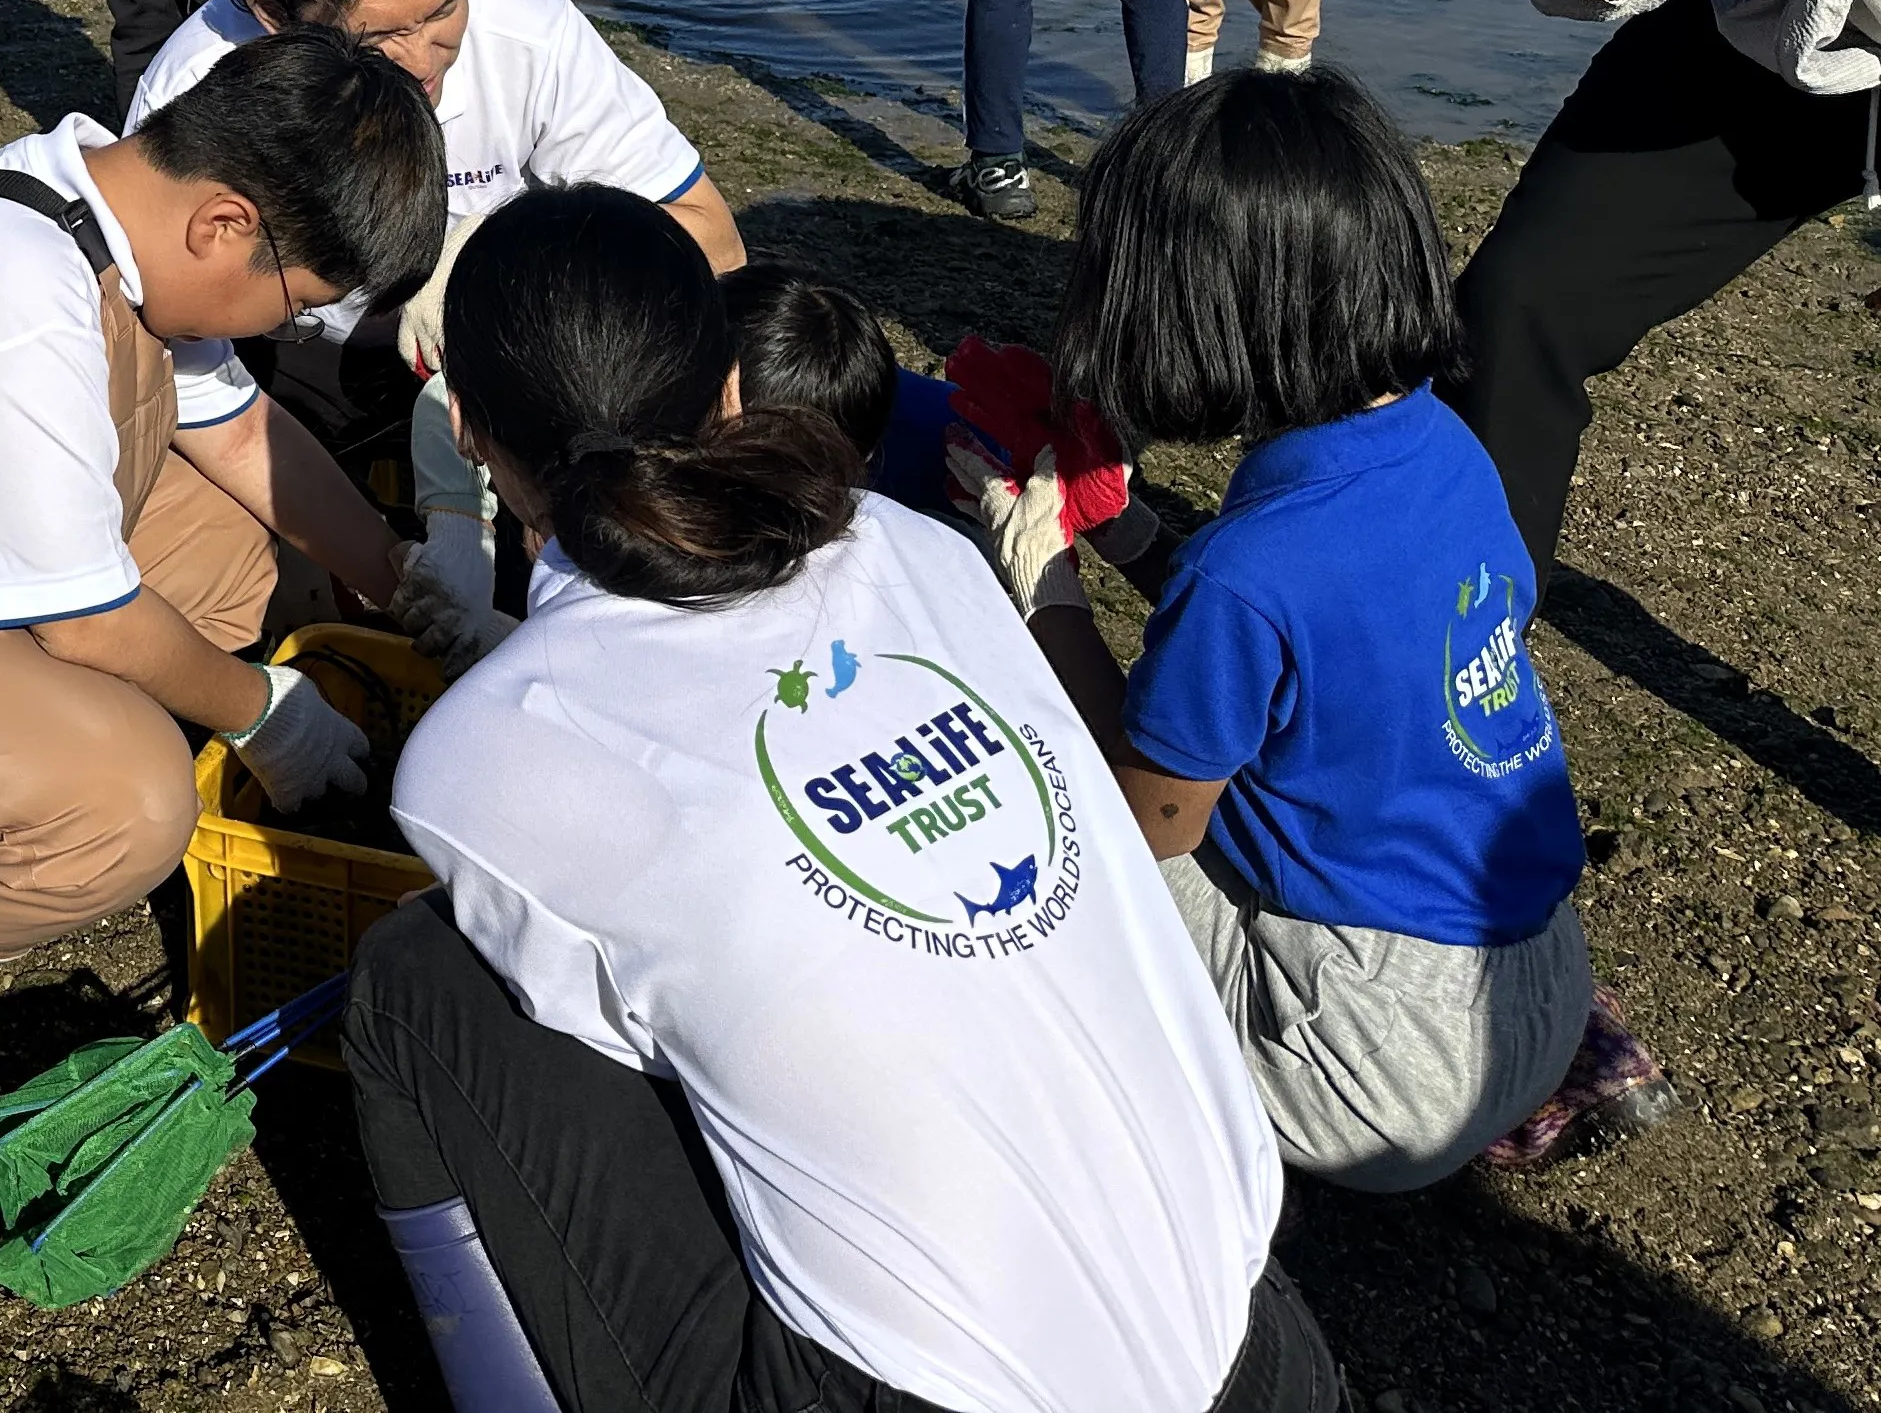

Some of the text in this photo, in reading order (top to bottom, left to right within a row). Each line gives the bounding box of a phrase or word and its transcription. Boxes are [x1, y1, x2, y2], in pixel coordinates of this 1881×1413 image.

[1479, 659, 1521, 718] TRUST
[804, 751, 924, 835] SEA
[1498, 752, 1524, 778] THE
[785, 722, 1082, 960] PROTECTING THE WORLD'S OCEANS
[886, 773, 1003, 855] TRUST
